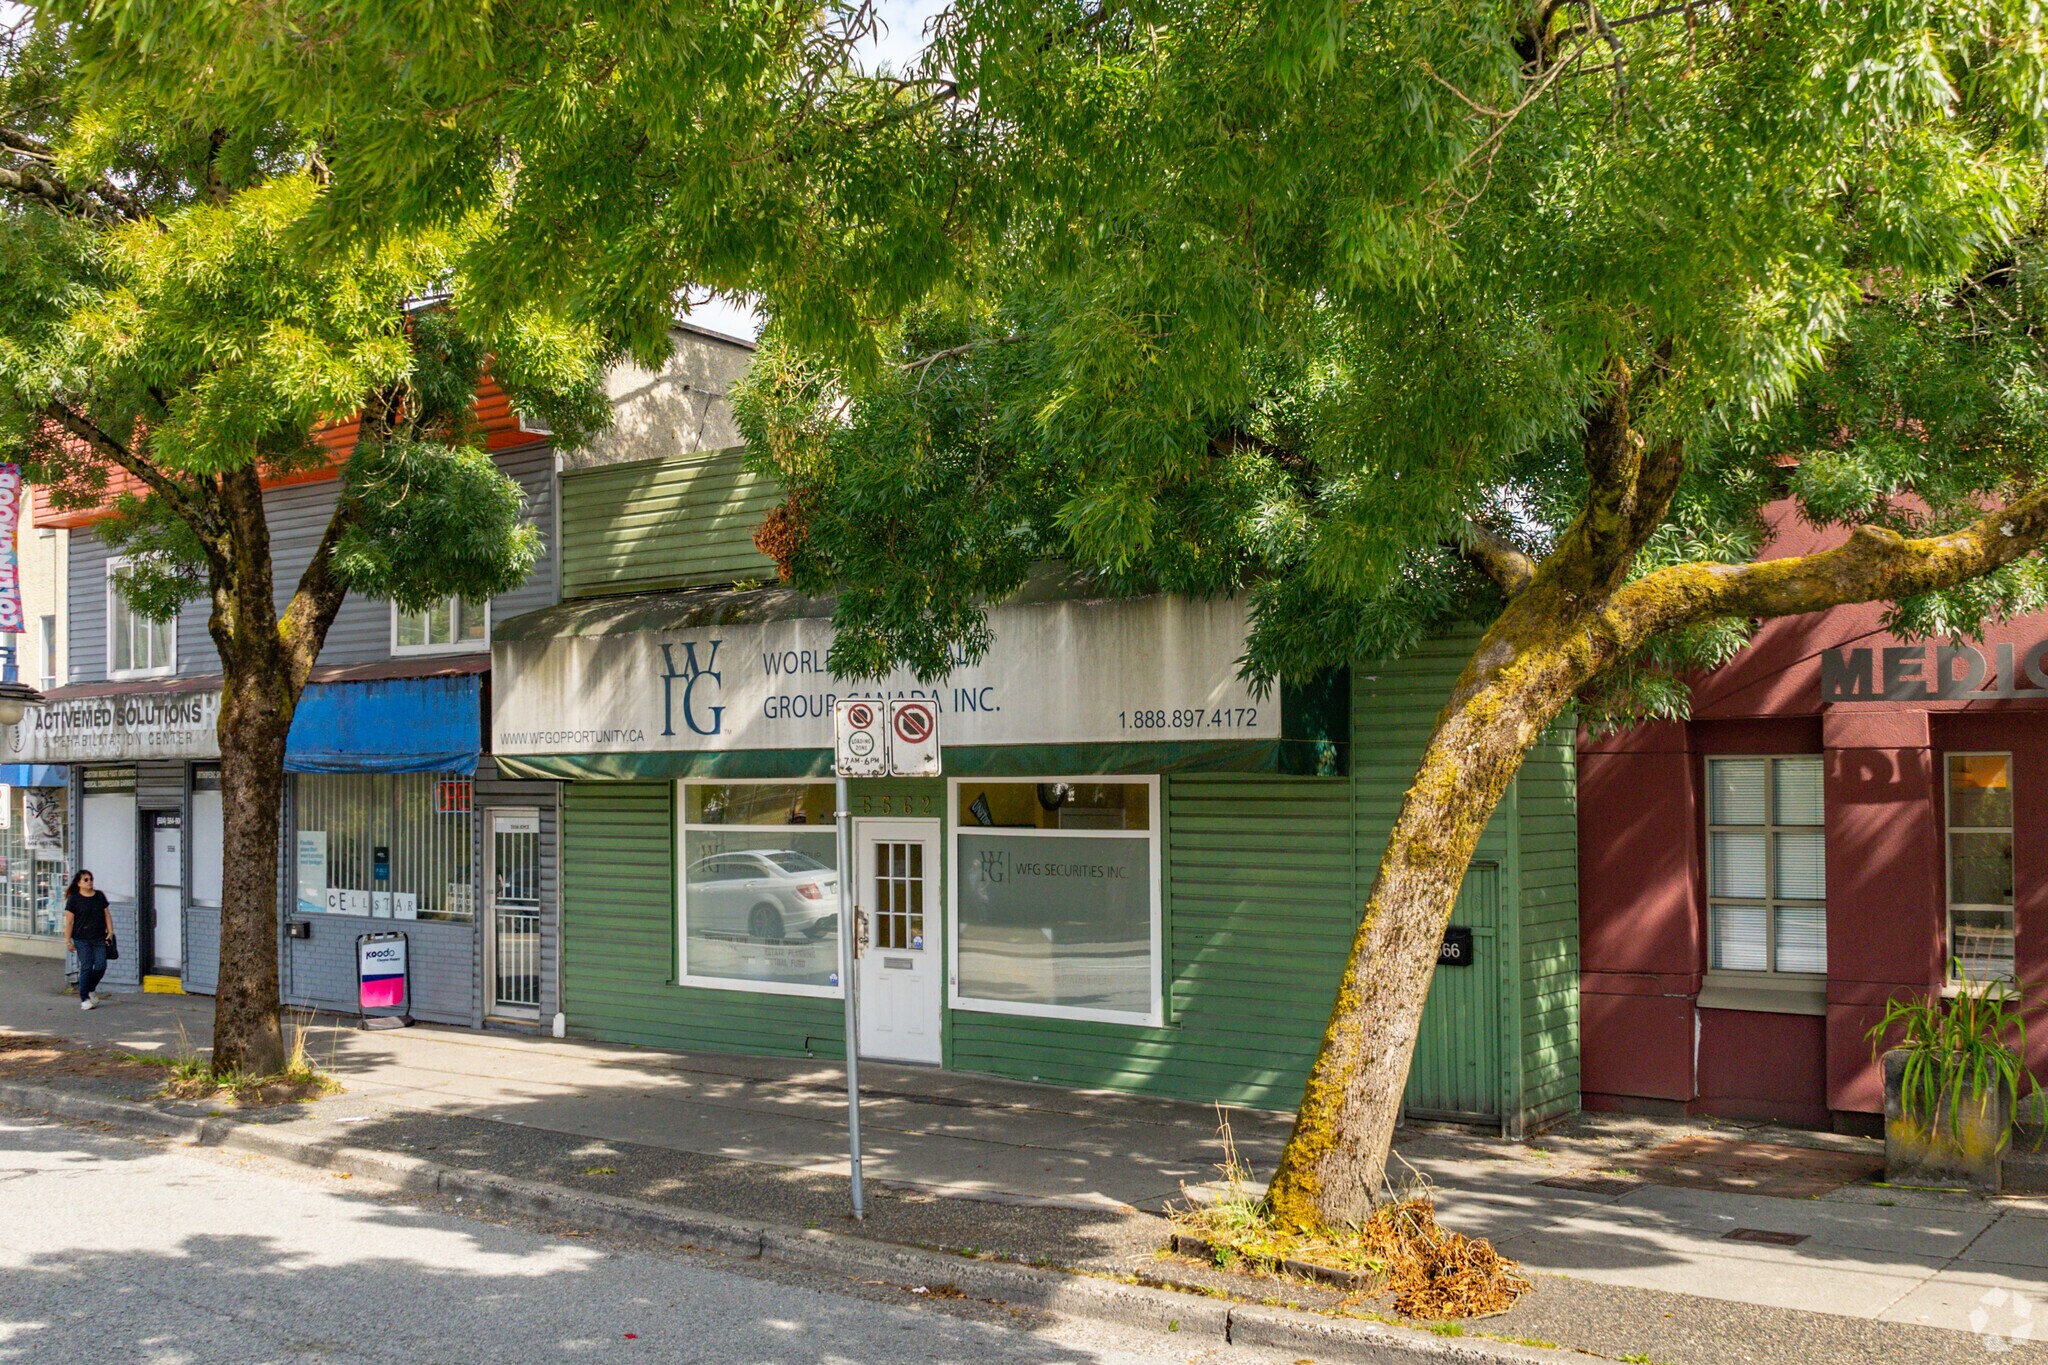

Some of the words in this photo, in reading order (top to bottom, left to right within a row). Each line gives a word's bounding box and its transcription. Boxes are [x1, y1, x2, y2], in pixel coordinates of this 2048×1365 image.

[954, 687, 1000, 713] INC.
[36, 707, 112, 730] ACTIVEMED
[117, 703, 201, 726] SOLUTIONS
[1119, 708, 1257, 729] 1.888.897.4172
[53, 732, 142, 748] REHABILITATION
[149, 731, 192, 746] CENTER
[500, 729, 645, 745] WWW.WFGOPPORTUNITY.CA
[863, 795, 931, 815] 5562
[1016, 863, 1041, 876] WFG
[1045, 863, 1103, 878] SECURITIES
[1107, 866, 1129, 879] INC.
[1440, 943, 1460, 958] 66
